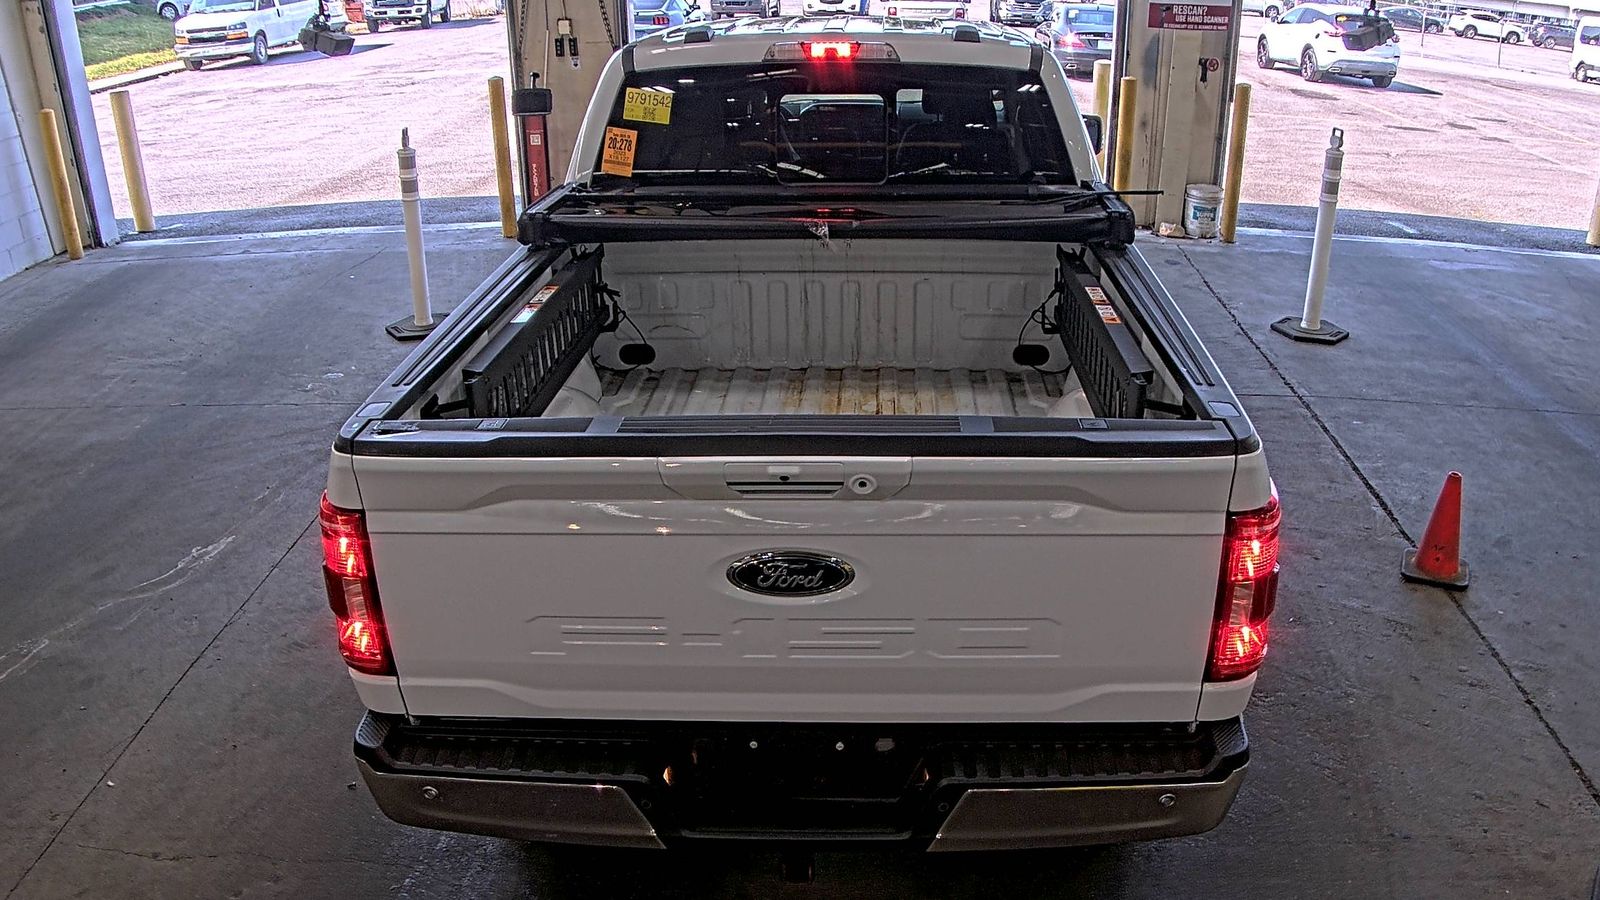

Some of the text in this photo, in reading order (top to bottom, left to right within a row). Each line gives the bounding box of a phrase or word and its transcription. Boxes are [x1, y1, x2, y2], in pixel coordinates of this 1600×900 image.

[1173, 5, 1207, 15] RESCAN?
[1187, 15, 1202, 23] HAND
[1203, 16, 1229, 24] SCANNER
[627, 91, 671, 108] 9791542
[608, 136, 632, 152] 20:278
[757, 561, 824, 588] Ford
